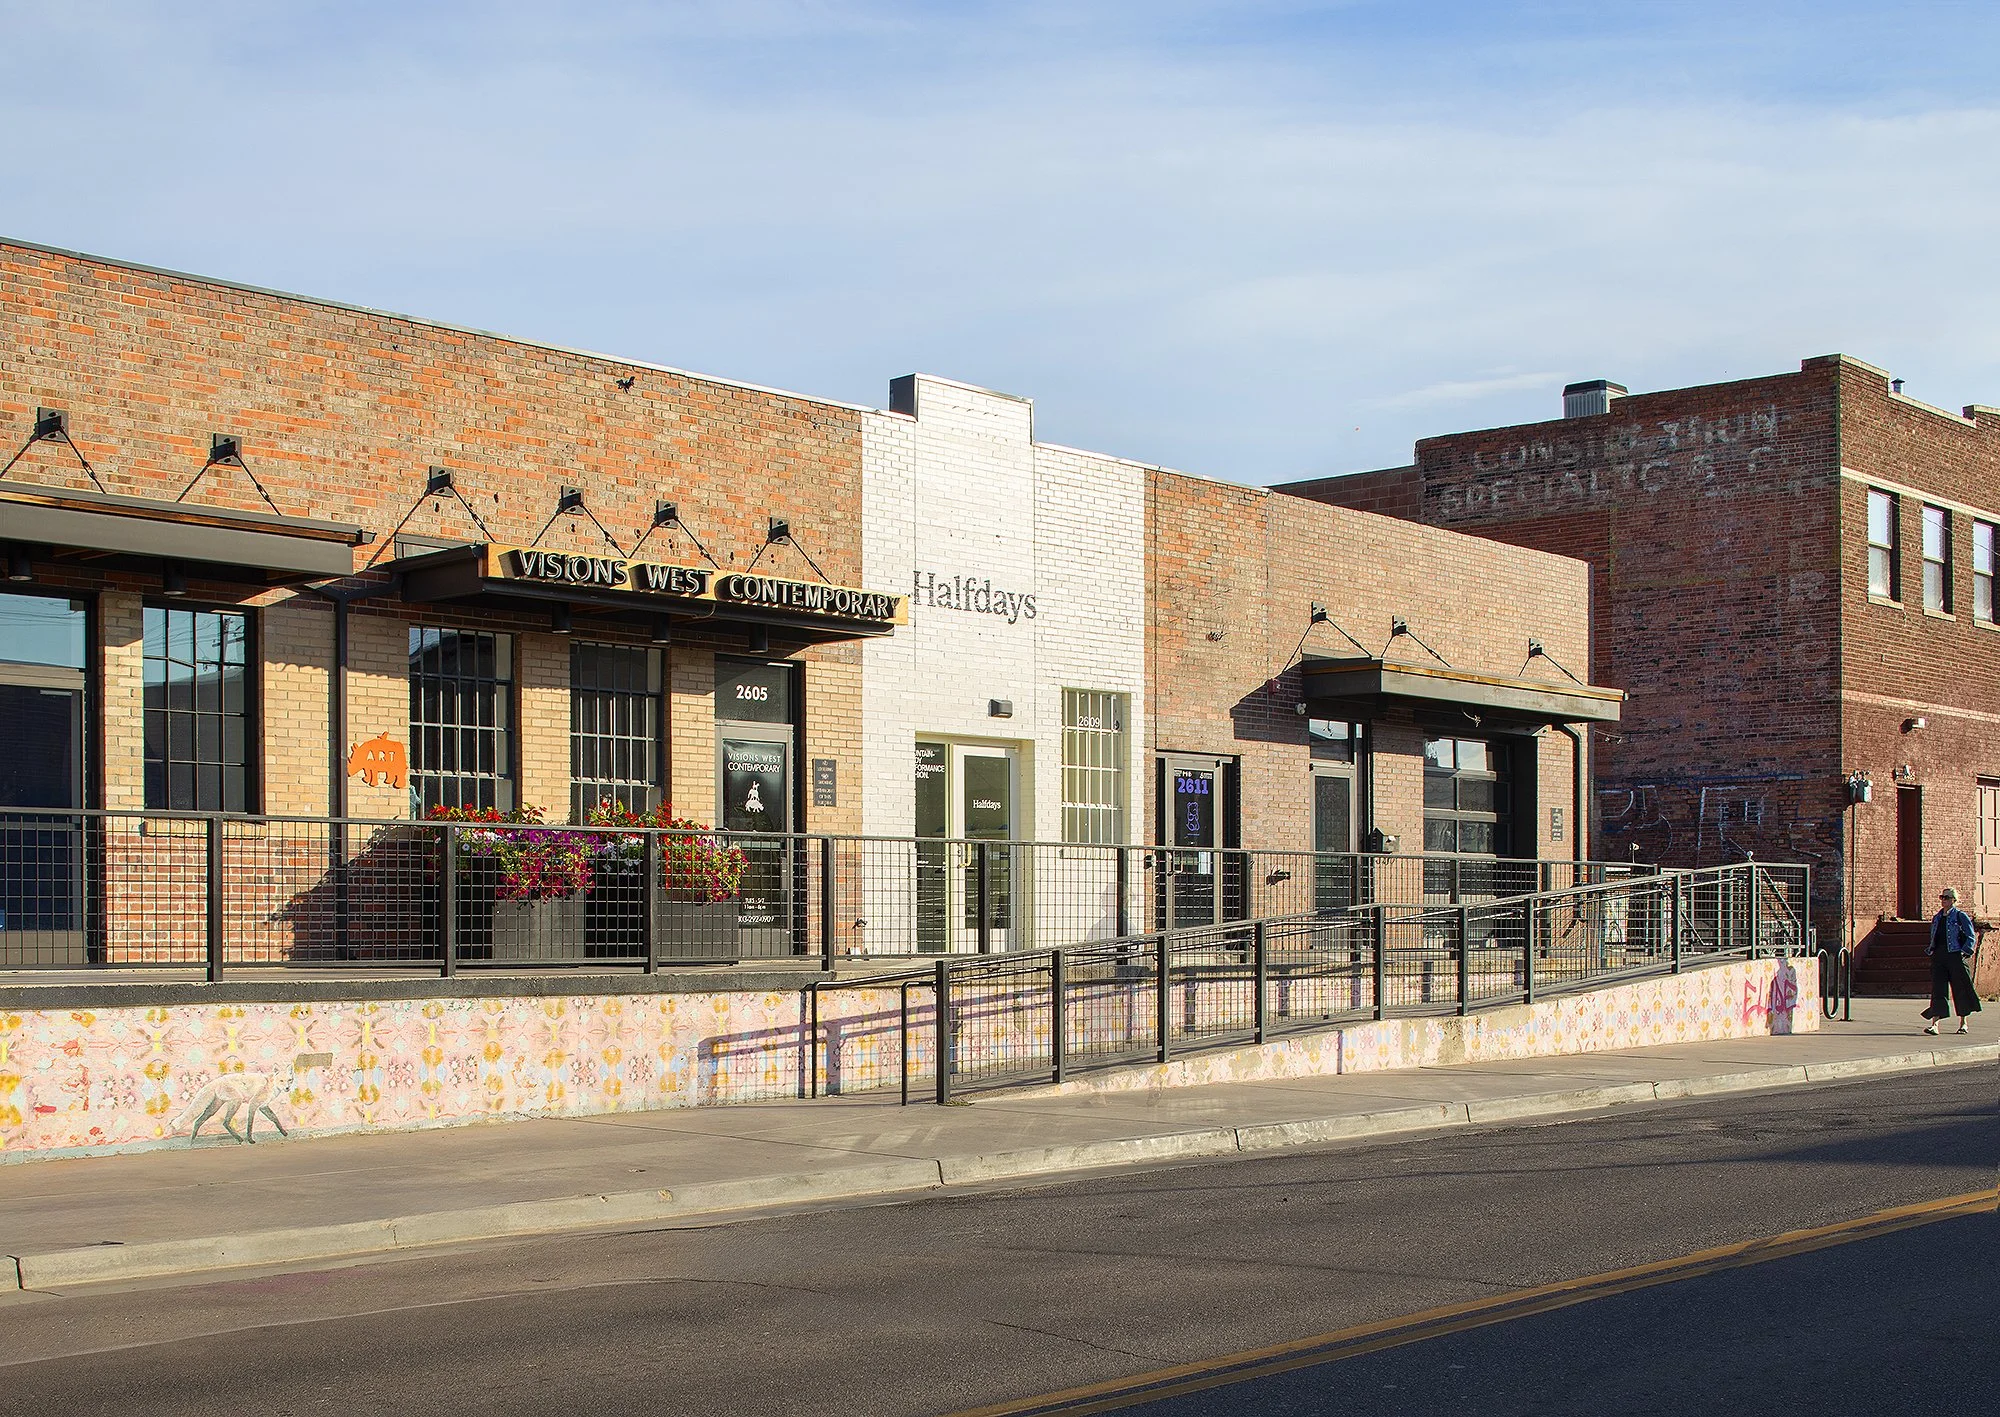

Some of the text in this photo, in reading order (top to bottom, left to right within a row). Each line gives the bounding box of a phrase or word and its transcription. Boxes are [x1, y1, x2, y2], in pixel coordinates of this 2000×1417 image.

[516, 548, 901, 619] VISIONS WEST CONTEMPORARY
[913, 570, 1037, 625] Halfdays
[735, 684, 769, 701] 2605
[1079, 715, 1101, 728] 2609
[366, 749, 396, 762] ART
[728, 752, 782, 763] VISIONS WEST
[915, 750, 935, 758] NTAIN-
[727, 762, 781, 773] CONTEMPORARY
[1177, 777, 1209, 795] 2611
[972, 799, 1002, 811] Halfdays
